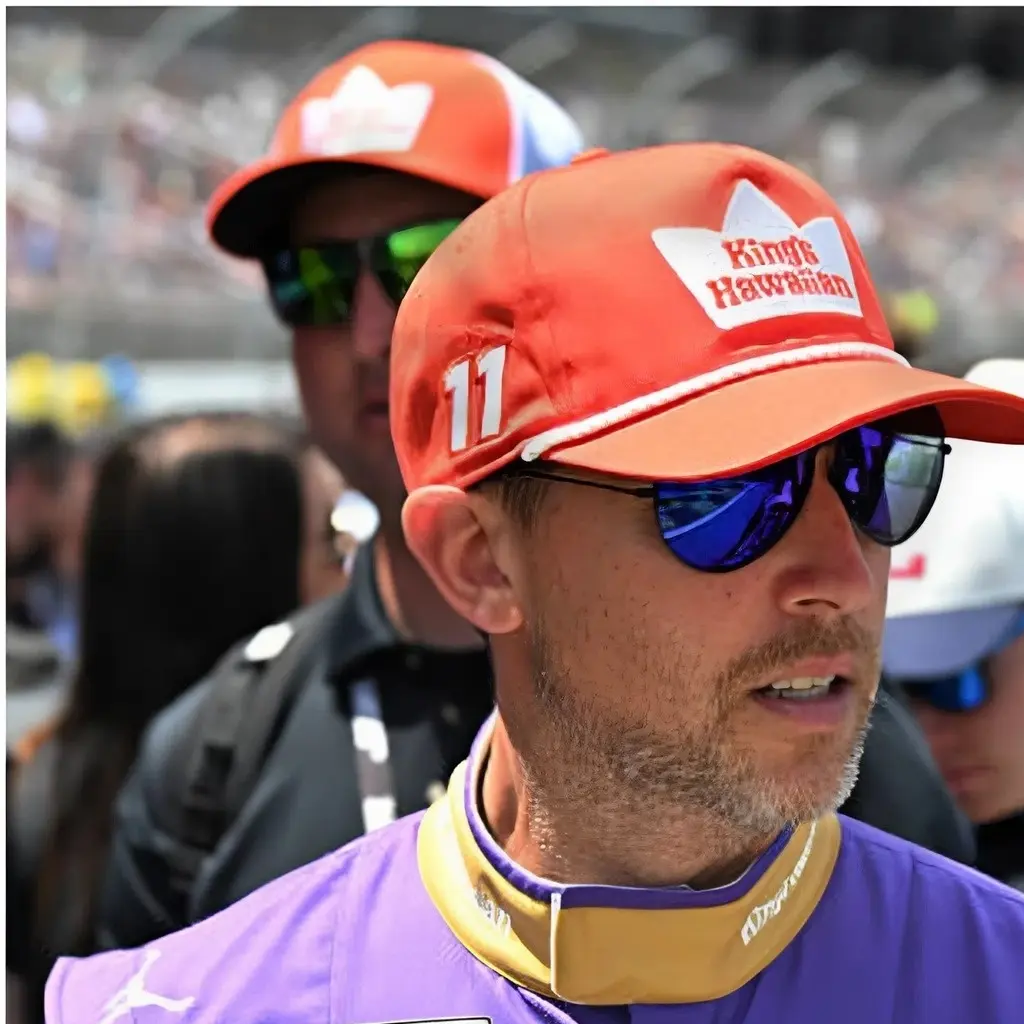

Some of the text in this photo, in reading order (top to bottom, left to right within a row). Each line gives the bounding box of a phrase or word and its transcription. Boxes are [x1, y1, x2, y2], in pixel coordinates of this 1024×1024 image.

[720, 234, 820, 270] King's
[705, 268, 854, 310] Hawaiian
[442, 344, 506, 453] 11
